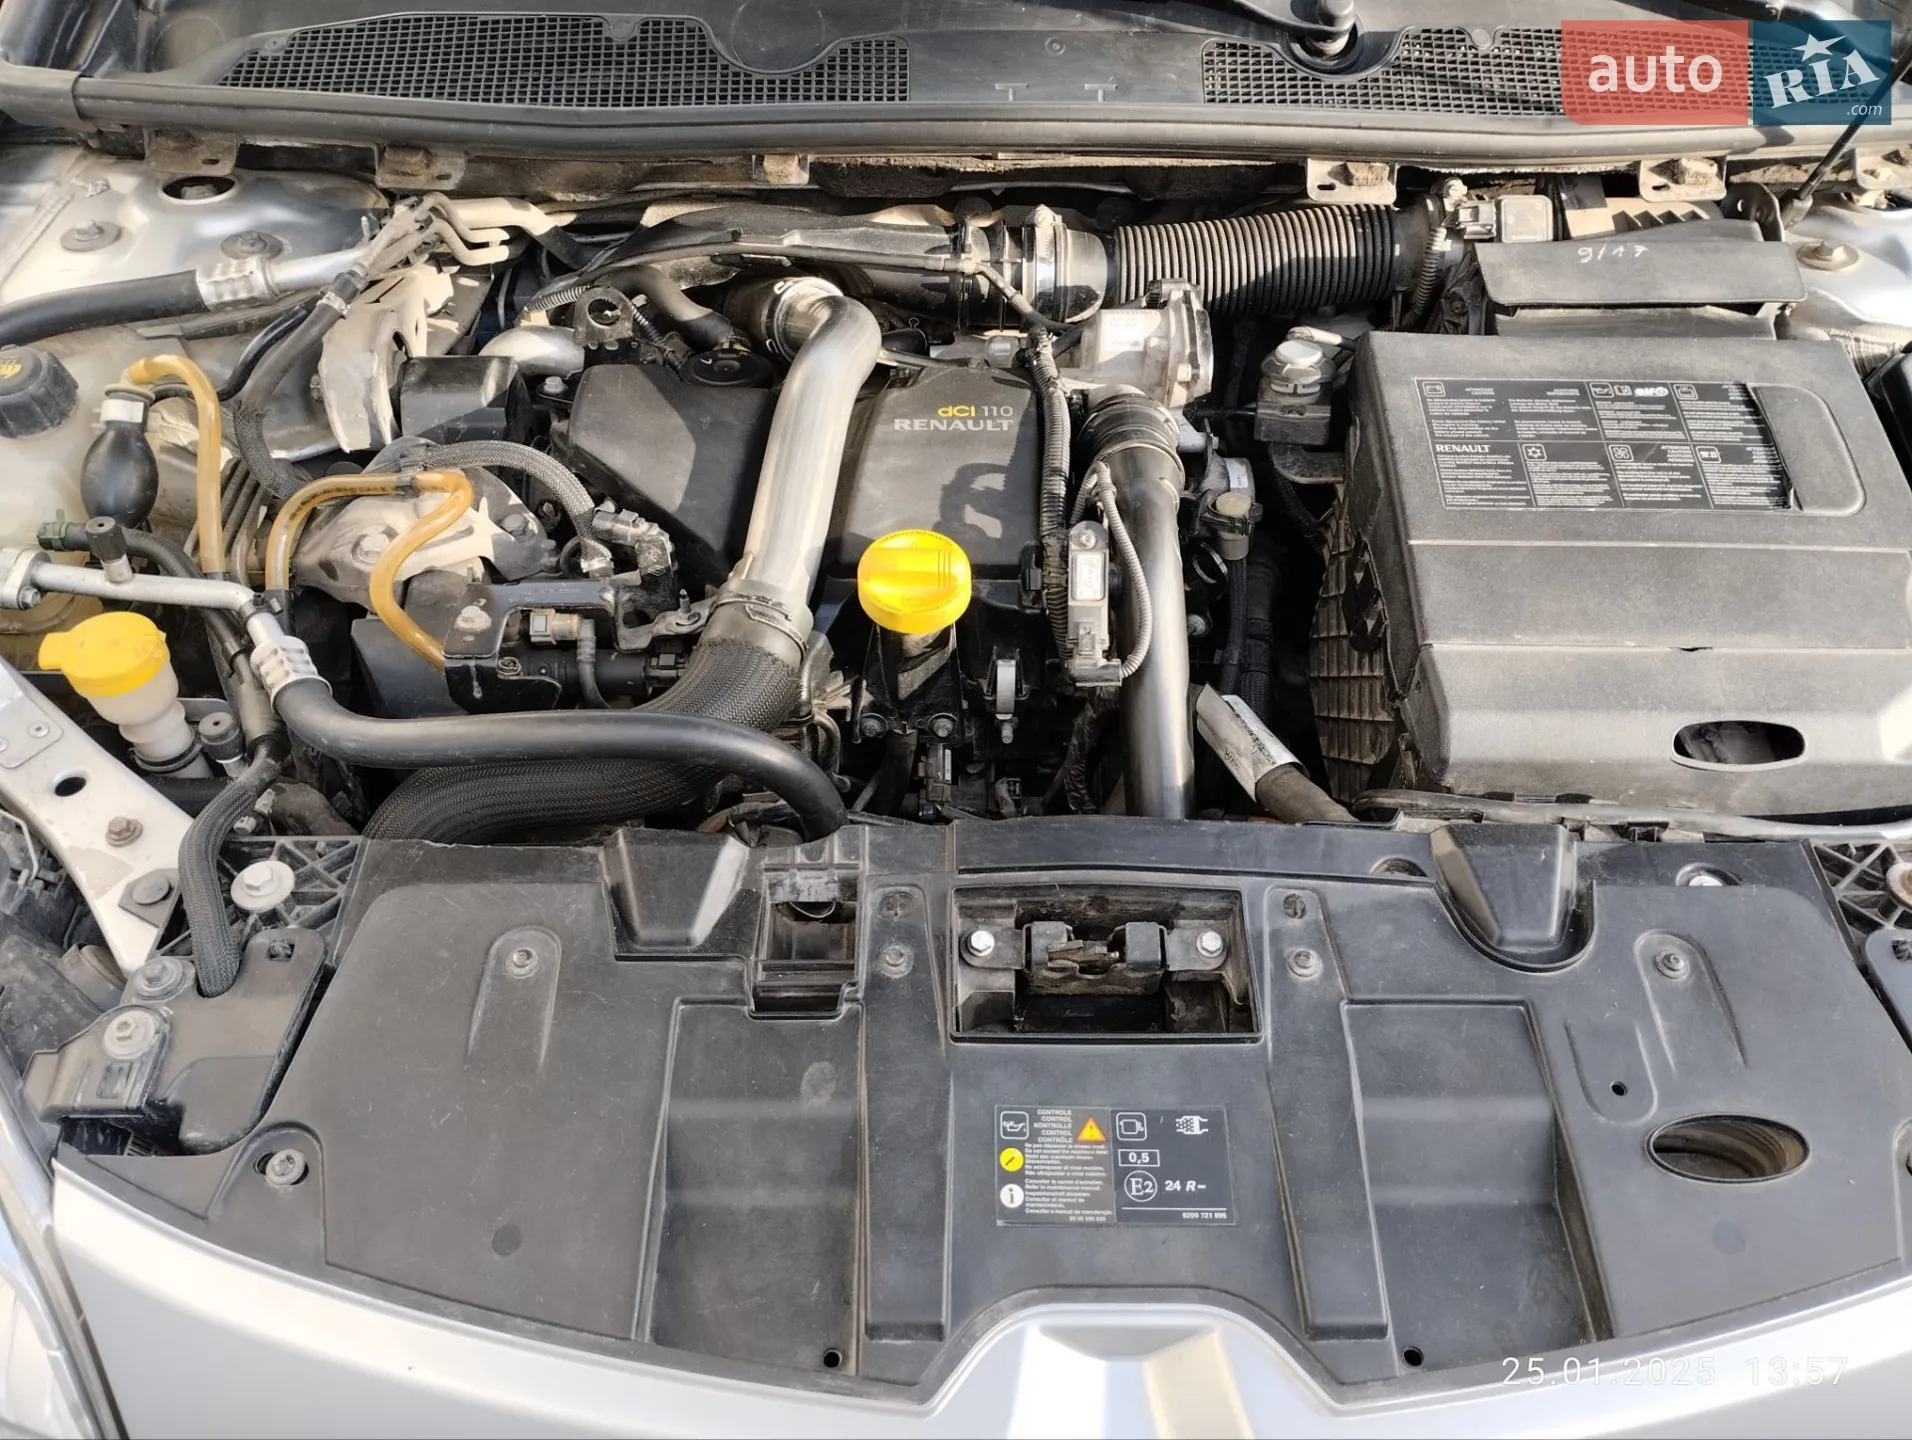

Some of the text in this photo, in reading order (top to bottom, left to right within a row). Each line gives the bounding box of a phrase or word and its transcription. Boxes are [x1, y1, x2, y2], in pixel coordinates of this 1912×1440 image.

[981, 405, 1014, 417] 110
[893, 418, 1014, 431] RENAULT
[1435, 444, 1491, 453] RENAULT
[1128, 1151, 1150, 1164] 0,5
[1129, 1177, 1154, 1195] E2
[1164, 1180, 1181, 1191] 24
